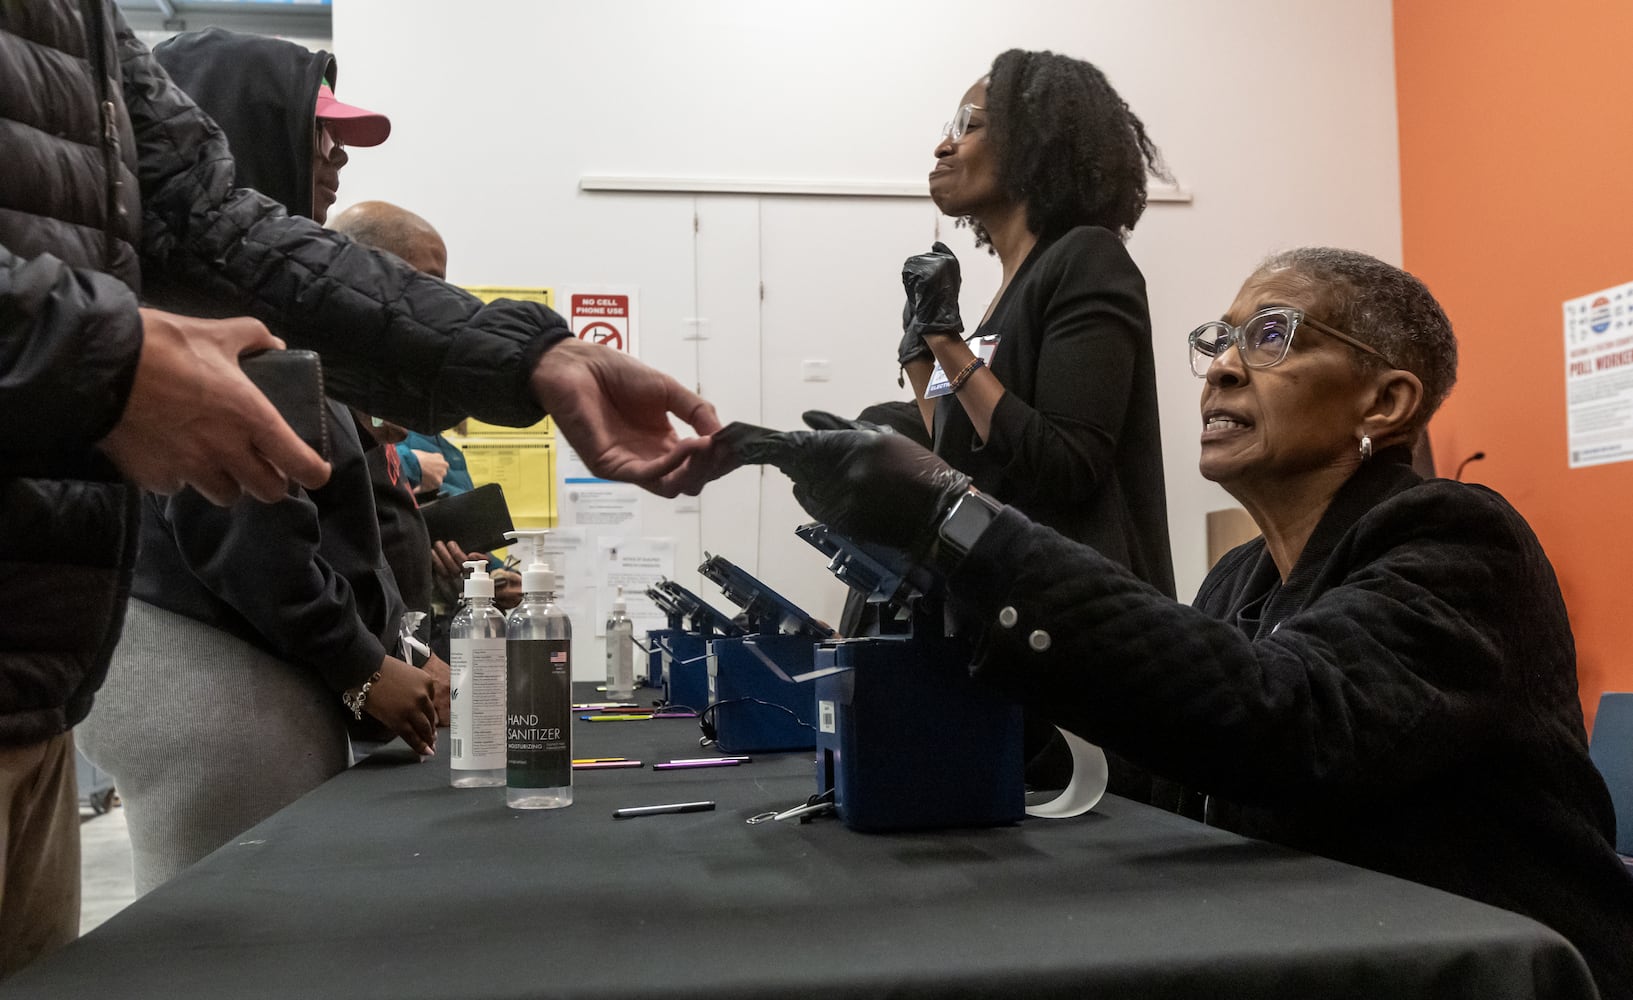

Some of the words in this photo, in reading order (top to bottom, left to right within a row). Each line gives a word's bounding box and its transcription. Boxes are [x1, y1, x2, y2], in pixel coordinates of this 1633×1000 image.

[582, 298, 595, 306] NO
[576, 307, 605, 315] PHONE
[1570, 359, 1593, 377] POLL
[508, 714, 539, 726] HAND
[508, 728, 561, 740] SANITIZER
